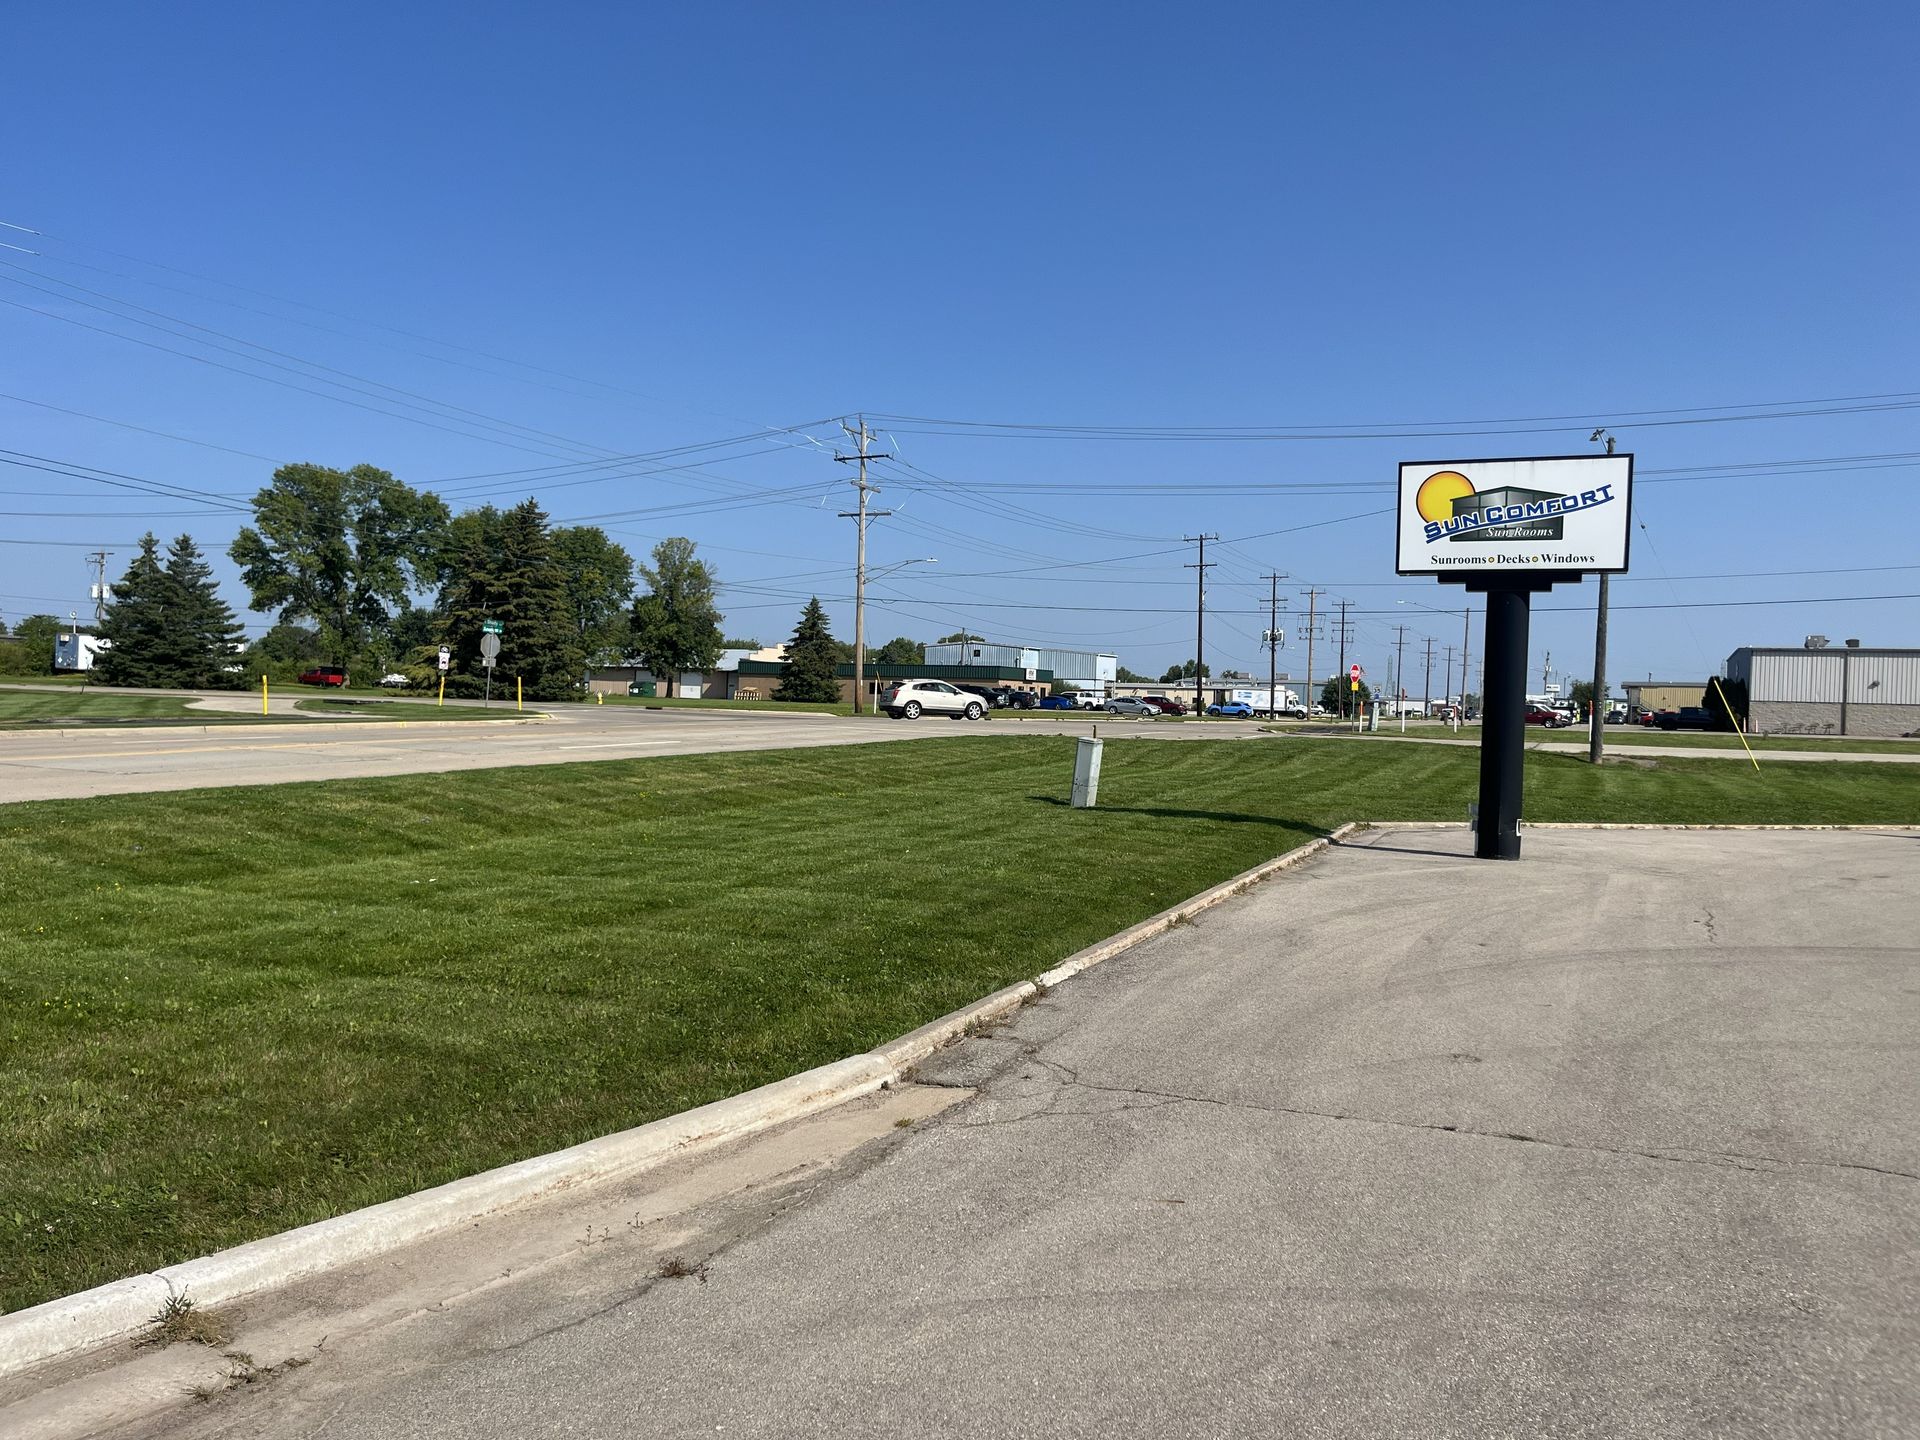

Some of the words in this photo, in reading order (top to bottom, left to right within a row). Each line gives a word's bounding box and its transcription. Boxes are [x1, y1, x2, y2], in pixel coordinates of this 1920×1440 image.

[1424, 513, 1479, 539] SUN
[1486, 483, 1615, 523] COMFORT
[1486, 527, 1510, 537] Sun
[1514, 527, 1554, 537] Rooms
[1430, 554, 1487, 565] Sunrooms
[1497, 554, 1531, 565] Decks
[1541, 553, 1595, 564] Windows
